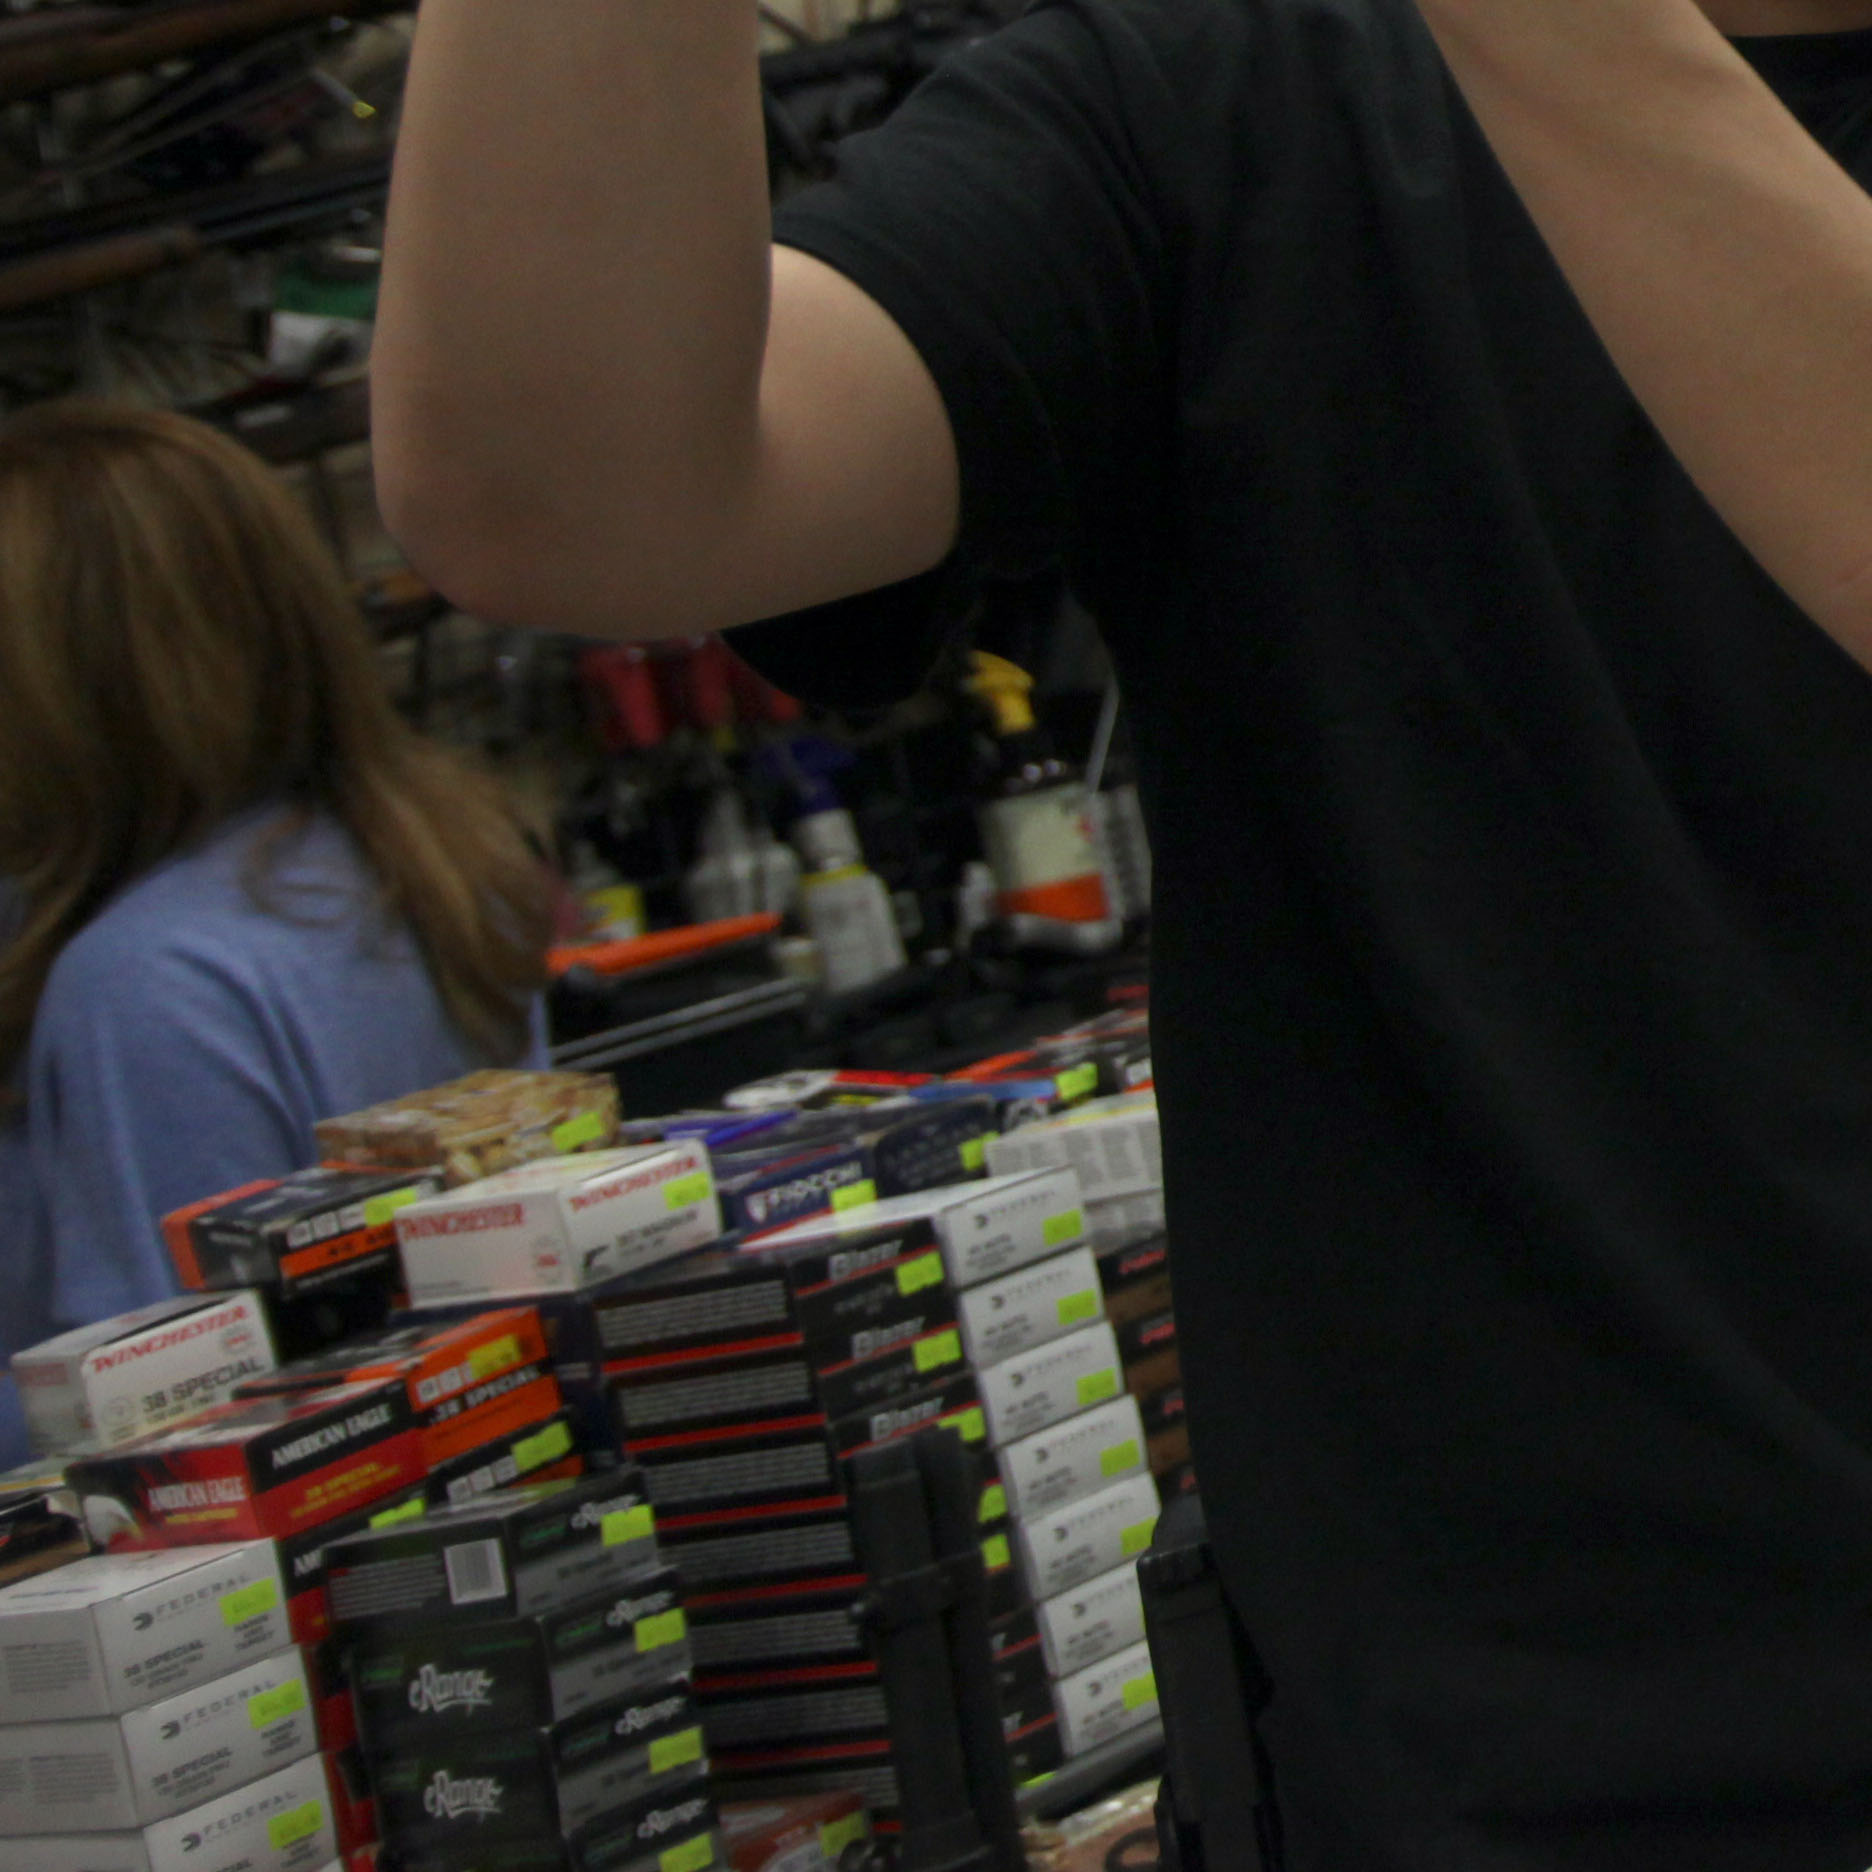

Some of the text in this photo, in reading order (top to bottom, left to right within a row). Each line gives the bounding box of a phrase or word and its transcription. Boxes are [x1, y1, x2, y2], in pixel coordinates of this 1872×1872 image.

[398, 1204, 523, 1240] WINCHESTER
[92, 1305, 248, 1372] WINCHESTER
[172, 1357, 264, 1400] SPECIAL
[272, 1403, 392, 1468] AMERICAN EAGLE
[148, 1476, 246, 1512] AMERICAN EAGLE
[156, 1574, 248, 1616] FEDERAL
[184, 1679, 275, 1723] FEDERAL
[205, 1791, 297, 1835] FEDERAL
